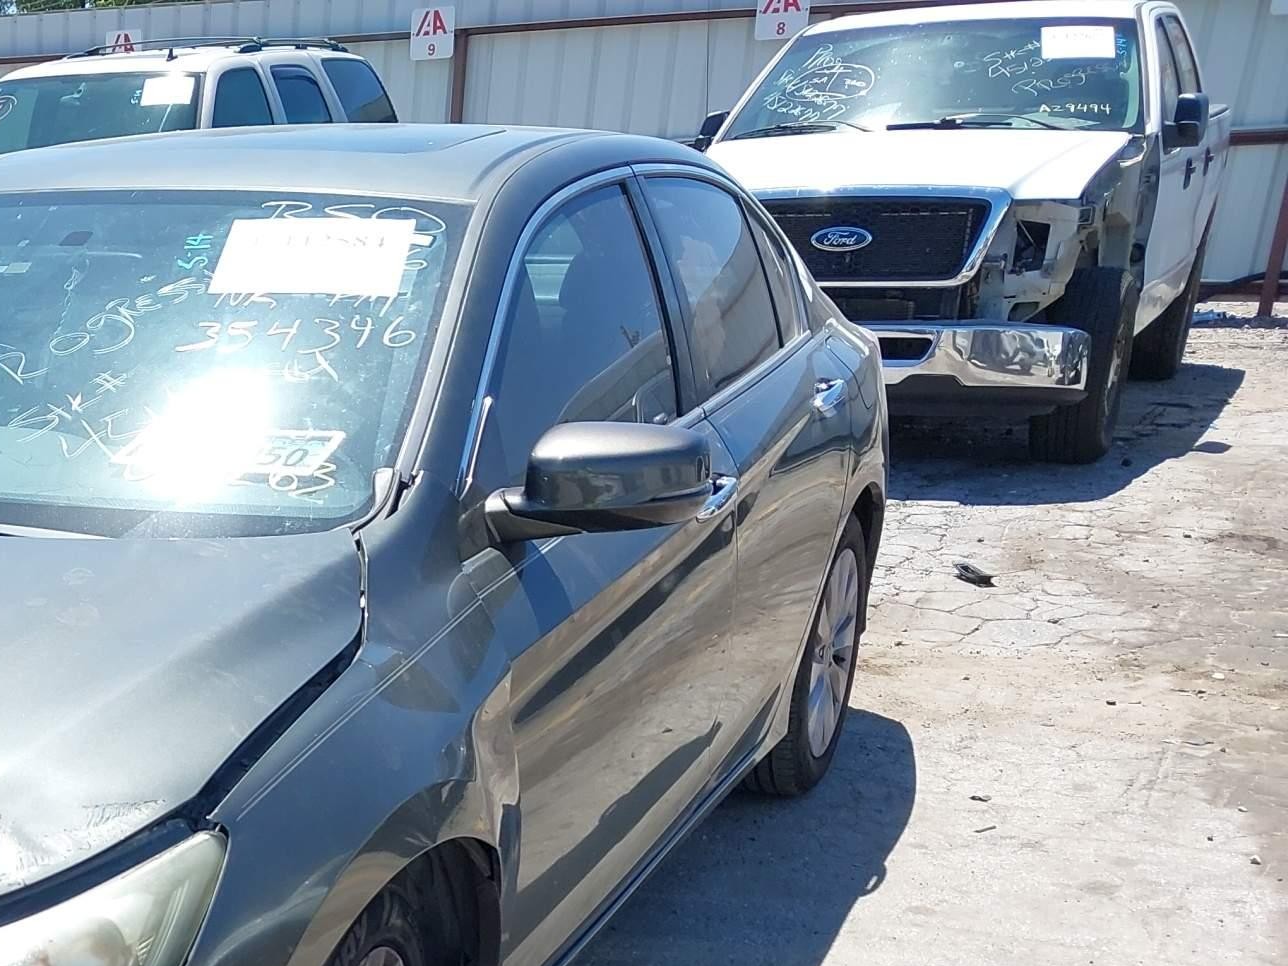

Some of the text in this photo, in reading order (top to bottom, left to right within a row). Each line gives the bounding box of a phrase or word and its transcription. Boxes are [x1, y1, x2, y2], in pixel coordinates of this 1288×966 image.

[776, 21, 786, 36] 8
[427, 43, 436, 57] 9
[823, 231, 858, 245] Ford
